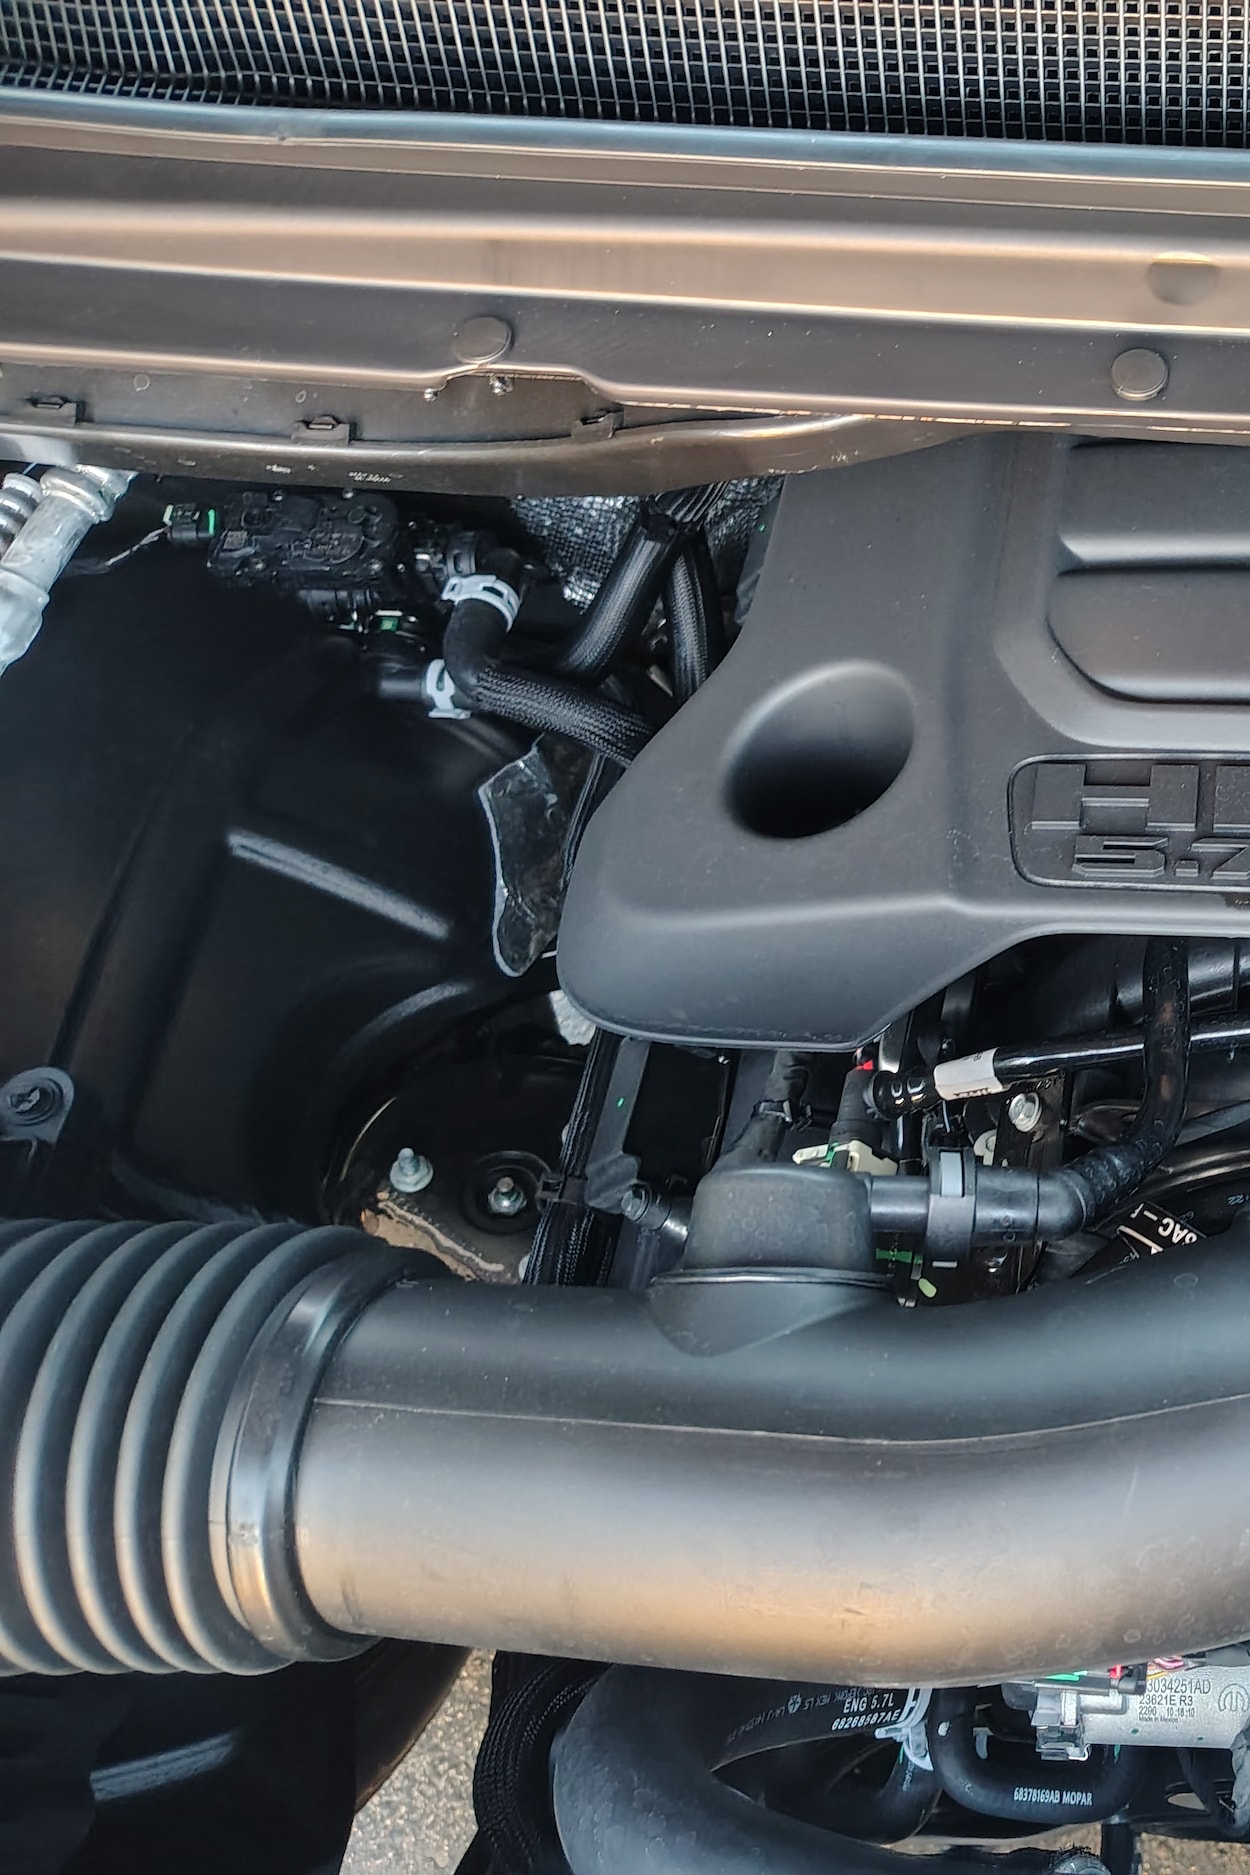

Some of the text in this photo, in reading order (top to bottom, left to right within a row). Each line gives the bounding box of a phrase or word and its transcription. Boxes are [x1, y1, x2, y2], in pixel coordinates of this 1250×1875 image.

[1146, 1677, 1212, 1695] 3034251AD
[843, 1697, 868, 1714] ENG
[870, 1692, 895, 1710] 5.7L
[1179, 1695, 1194, 1706] R3
[1062, 1789, 1093, 1807] MOPAR
